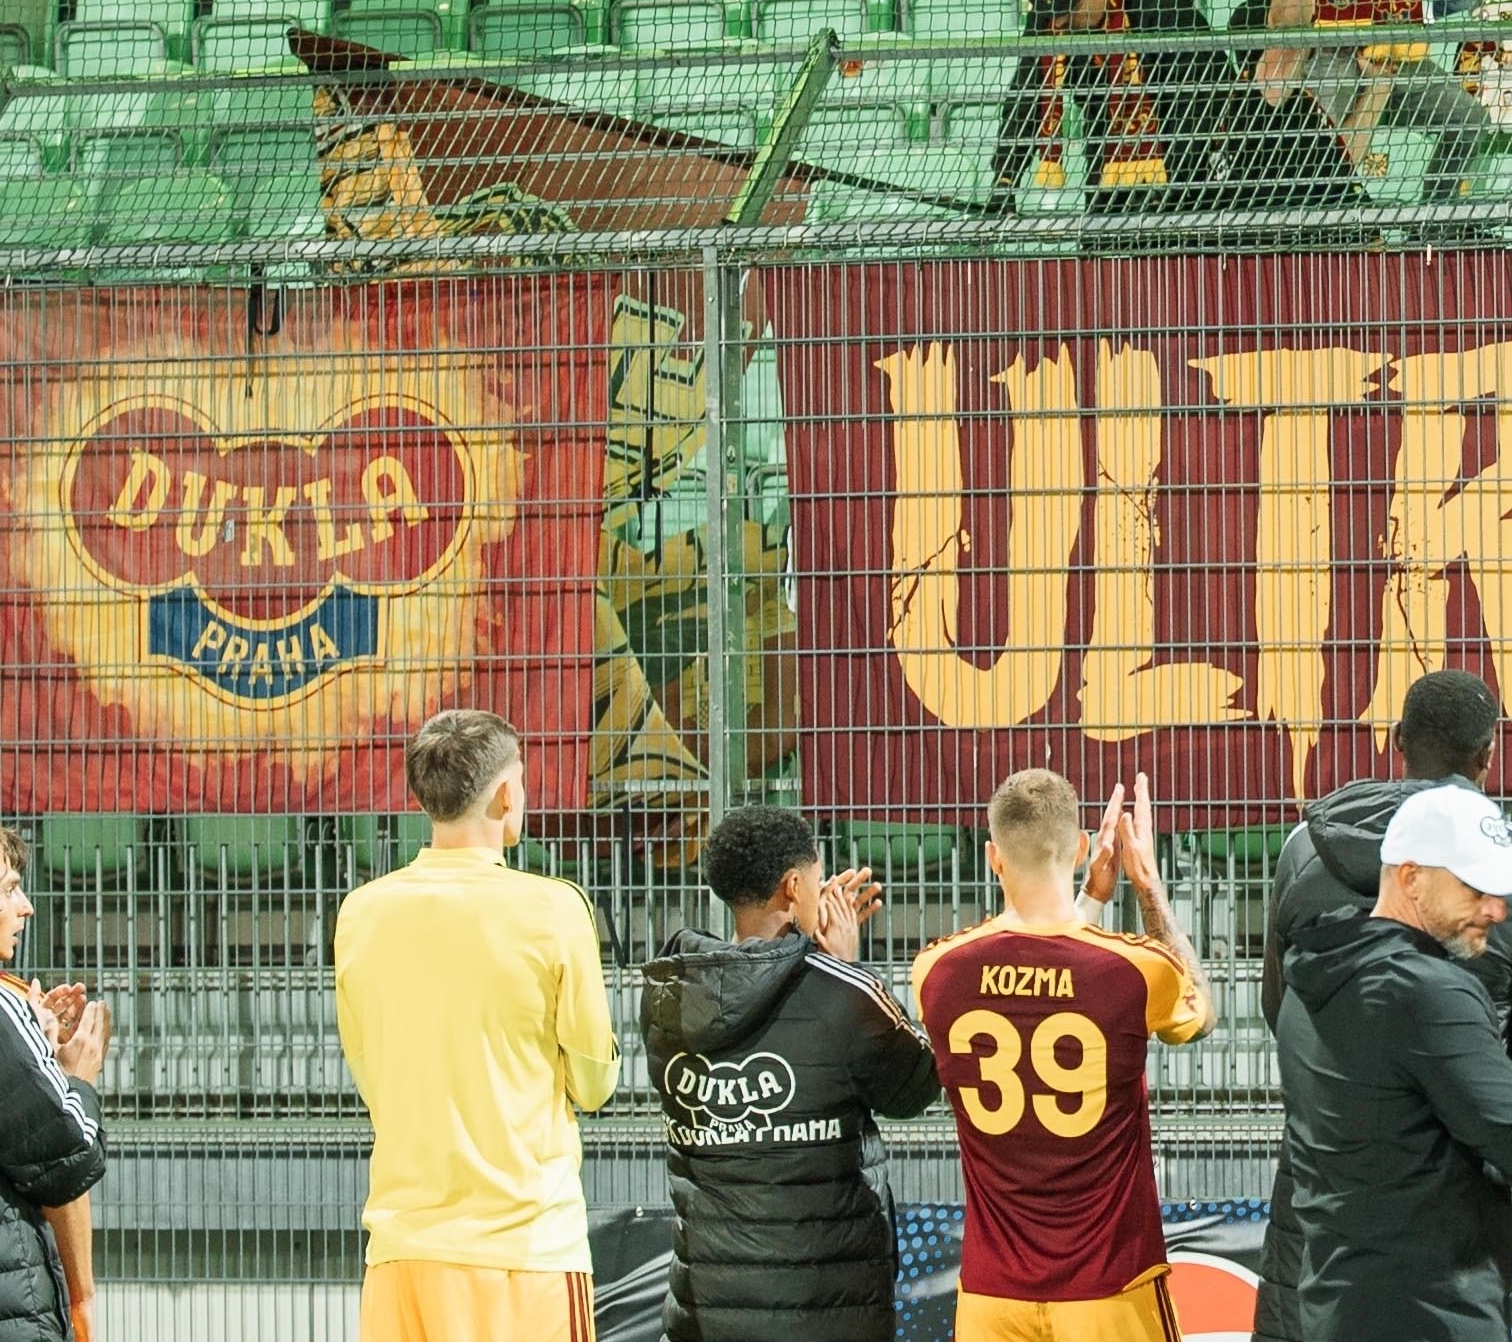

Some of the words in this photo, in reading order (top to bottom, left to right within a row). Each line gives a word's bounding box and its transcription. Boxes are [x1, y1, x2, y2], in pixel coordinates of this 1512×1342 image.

[106, 451, 433, 568] DUKLA
[193, 620, 340, 686] PRAHA
[981, 965, 1075, 1000] KOZMA
[676, 1066, 784, 1106] DUKLA
[948, 1009, 1108, 1139] 39
[708, 1117, 758, 1134] PRAHA
